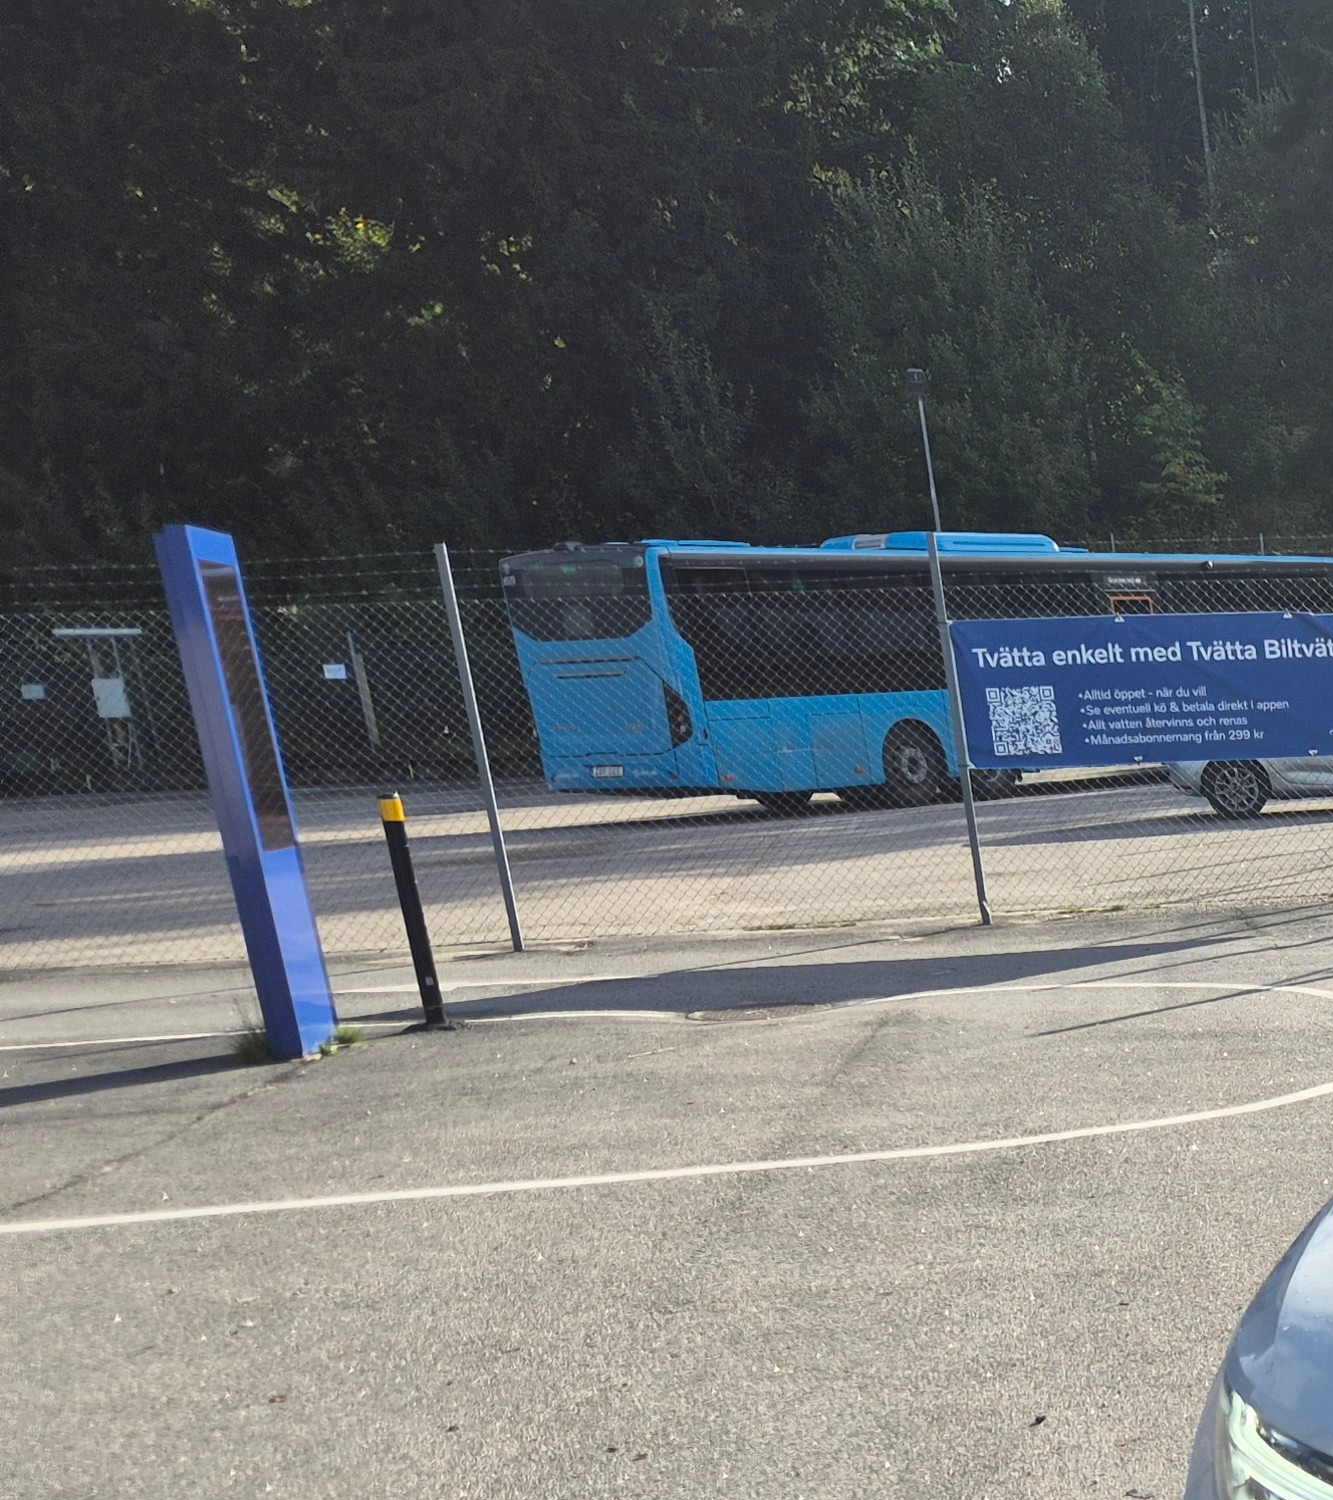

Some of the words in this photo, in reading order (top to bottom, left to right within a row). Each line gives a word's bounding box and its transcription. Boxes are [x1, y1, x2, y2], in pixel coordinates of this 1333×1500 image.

[972, 647, 1046, 669] Tvätta
[1052, 642, 1124, 666] enkelt
[1130, 642, 1182, 662] med
[1186, 639, 1258, 662] Tvätta
[1084, 688, 1111, 701] Alltid
[1113, 688, 1146, 701] öppet
[1155, 687, 1173, 698] när
[1175, 685, 1190, 698] du
[1192, 685, 1207, 697] vill
[1085, 705, 1101, 716] Se
[1103, 702, 1151, 715] eventuell
[1153, 702, 1167, 713] kö
[1169, 701, 1180, 713] &
[1182, 701, 1215, 712] betala
[1217, 699, 1248, 711] direkt
[1256, 701, 1290, 712] appen
[1087, 719, 1106, 731] Allt
[1108, 718, 1143, 730] vatten
[1145, 716, 1194, 729] återvinns
[1196, 716, 1216, 727] och
[1219, 717, 1248, 726] renas
[1089, 731, 1203, 745] Månadsabonnemang
[1204, 730, 1226, 741] från
[1228, 729, 1251, 741] 299
[1253, 728, 1264, 740] kr
